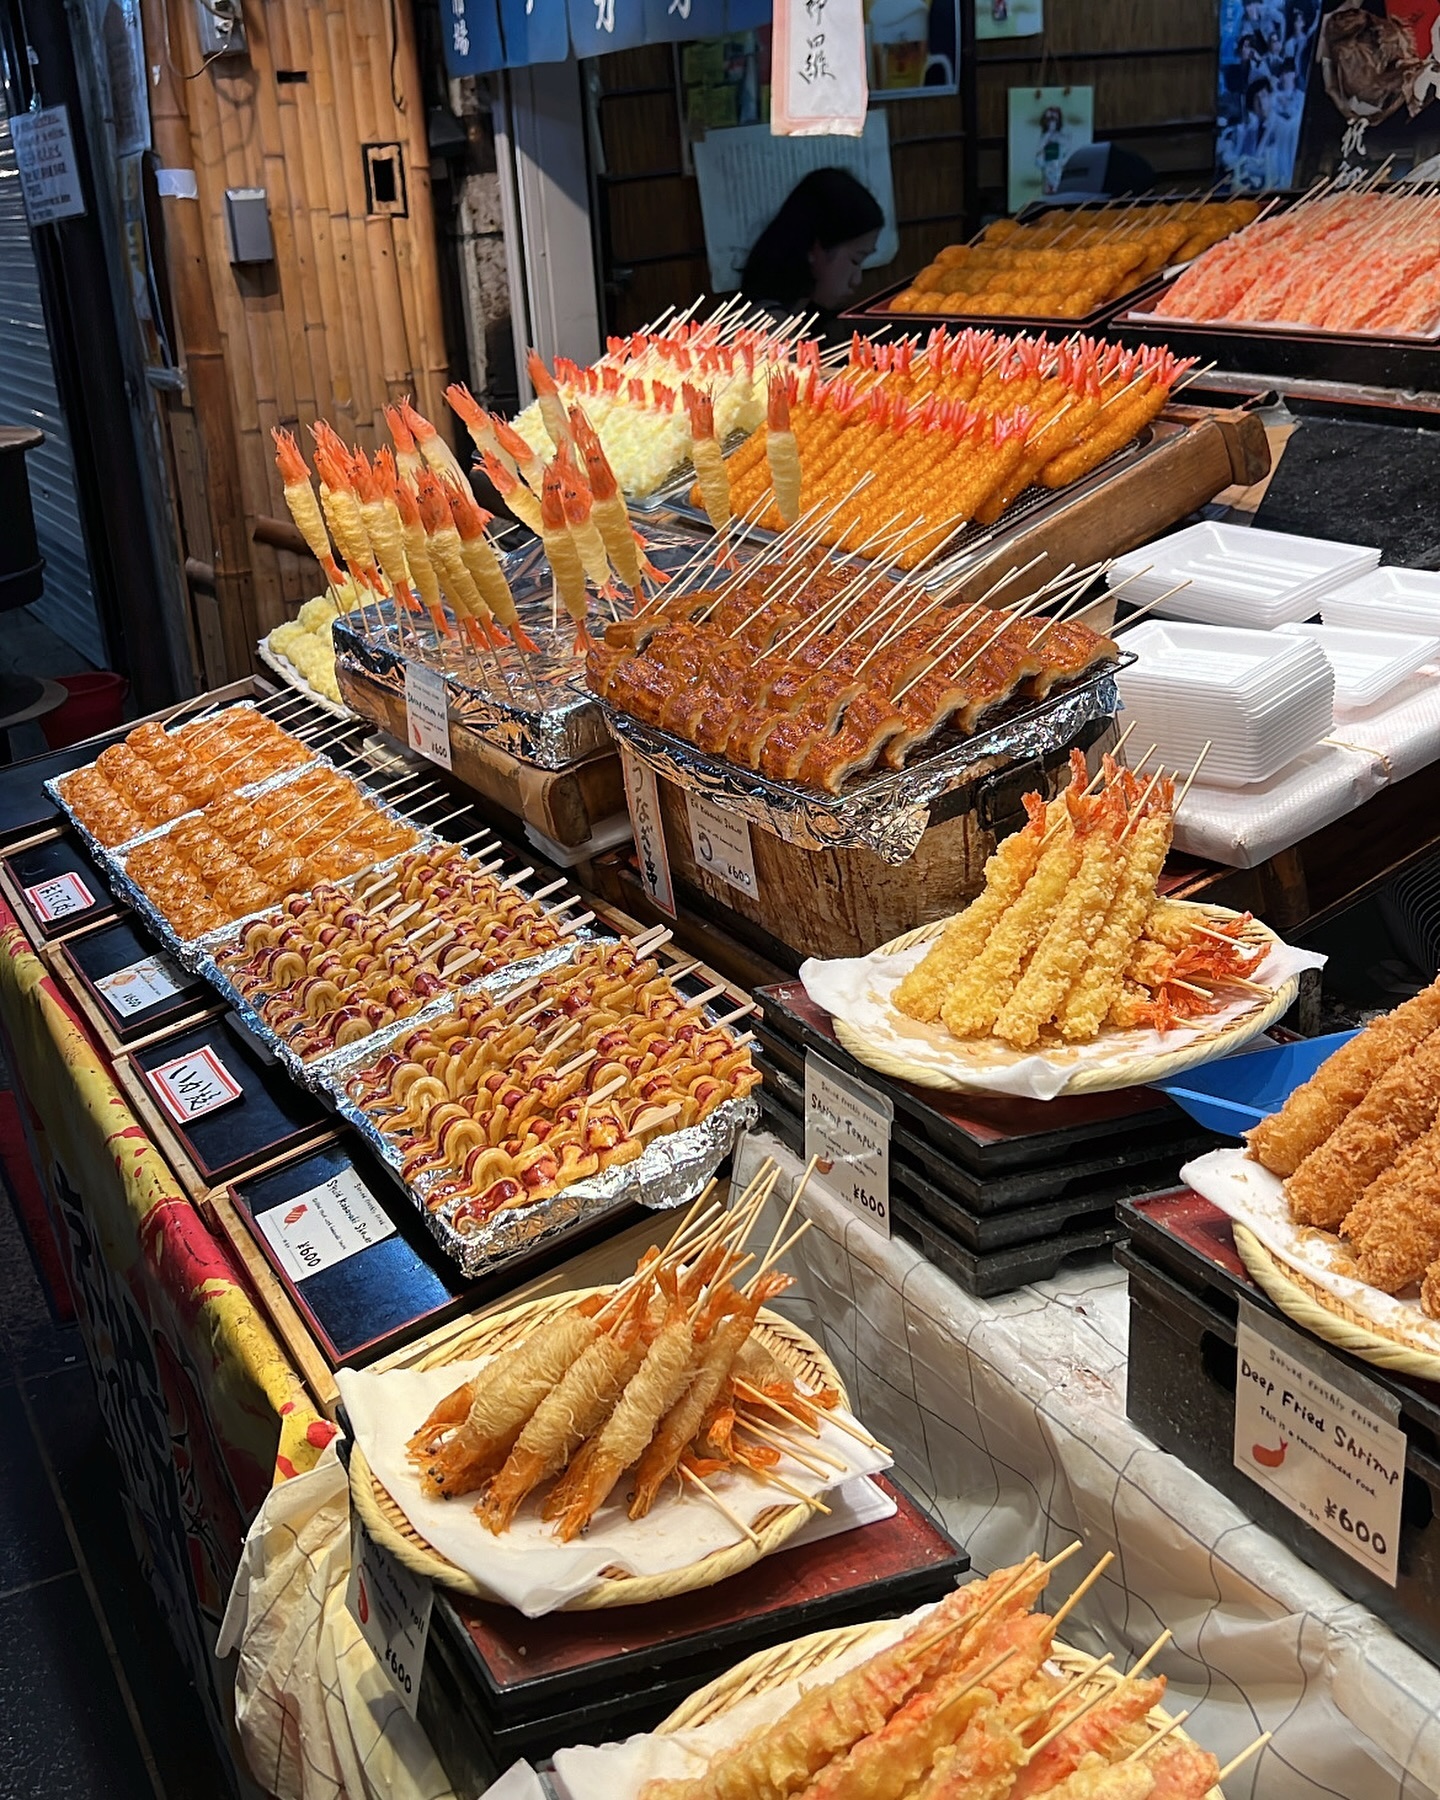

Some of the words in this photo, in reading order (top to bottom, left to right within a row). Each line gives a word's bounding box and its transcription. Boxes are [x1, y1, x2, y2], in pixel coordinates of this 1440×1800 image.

[811, 1093, 842, 1128] Shrimp
[844, 1119, 883, 1158] Tempura
[852, 1183, 886, 1219] ¥600
[295, 1240, 322, 1268] ¥600
[1268, 1348, 1303, 1381] Served
[1240, 1358, 1275, 1397] Deep
[1281, 1390, 1326, 1433] Fried
[1333, 1425, 1400, 1486] Shrimp
[1258, 1404, 1278, 1426] This
[1278, 1420, 1287, 1432] is
[1287, 1429, 1295, 1438] a
[1323, 1496, 1388, 1556] ¥600
[385, 1641, 413, 1695] ¥600
